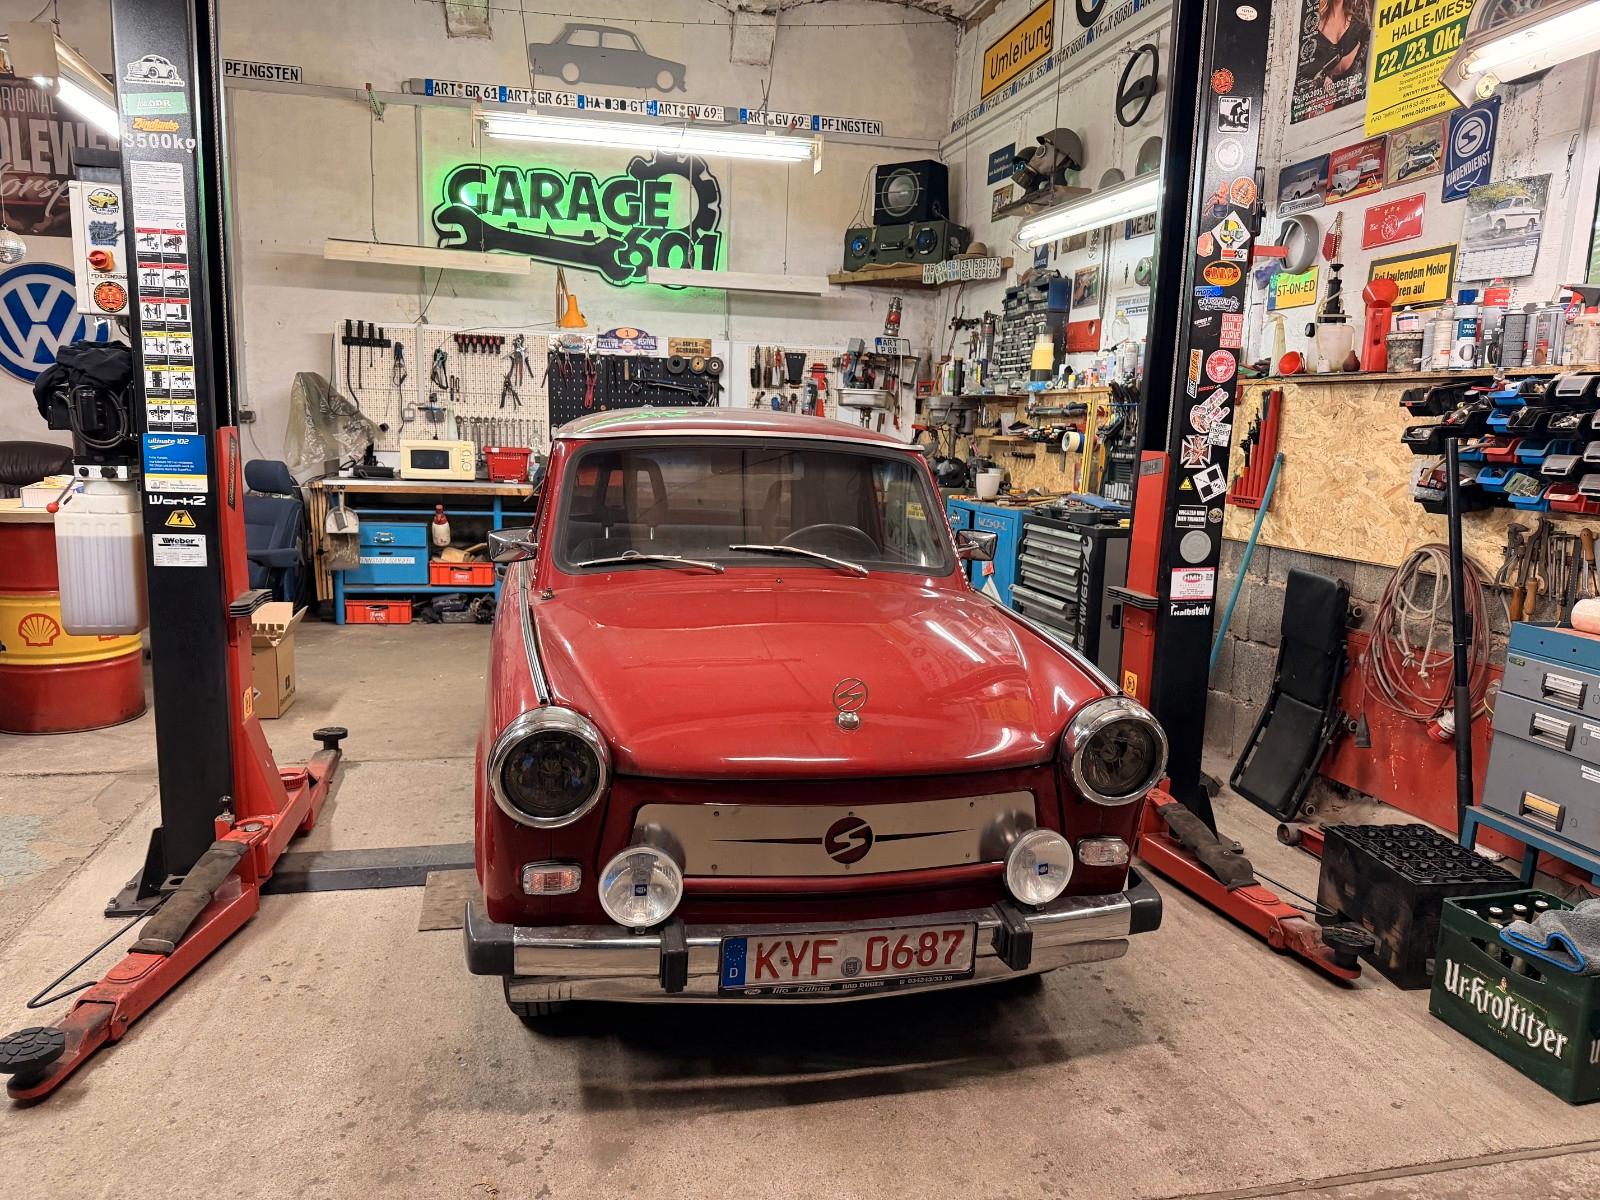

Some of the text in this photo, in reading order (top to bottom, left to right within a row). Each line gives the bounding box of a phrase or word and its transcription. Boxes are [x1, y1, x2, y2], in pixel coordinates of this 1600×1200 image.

[1392, 0, 1474, 43] HALLE-MESS
[990, 18, 1053, 80] Umleitung
[1379, 23, 1465, 78] 22./23. Okt.
[225, 61, 299, 81] PFINGSTEN
[434, 82, 499, 99] ART GR 61
[507, 87, 569, 106] ART GR 61
[0, 87, 58, 115] RIGINAL
[659, 103, 717, 119] ART GV 69
[748, 111, 805, 128] ART GV 69
[821, 117, 881, 135] PFINGSTEN
[448, 167, 673, 229] GARAGE
[618, 227, 719, 277] 601
[1425, 263, 1448, 277] Motor
[1277, 279, 1316, 297] ST-ON-ED
[1413, 280, 1426, 295] auf
[755, 929, 966, 979] KYF 0687
[729, 967, 739, 979] D
